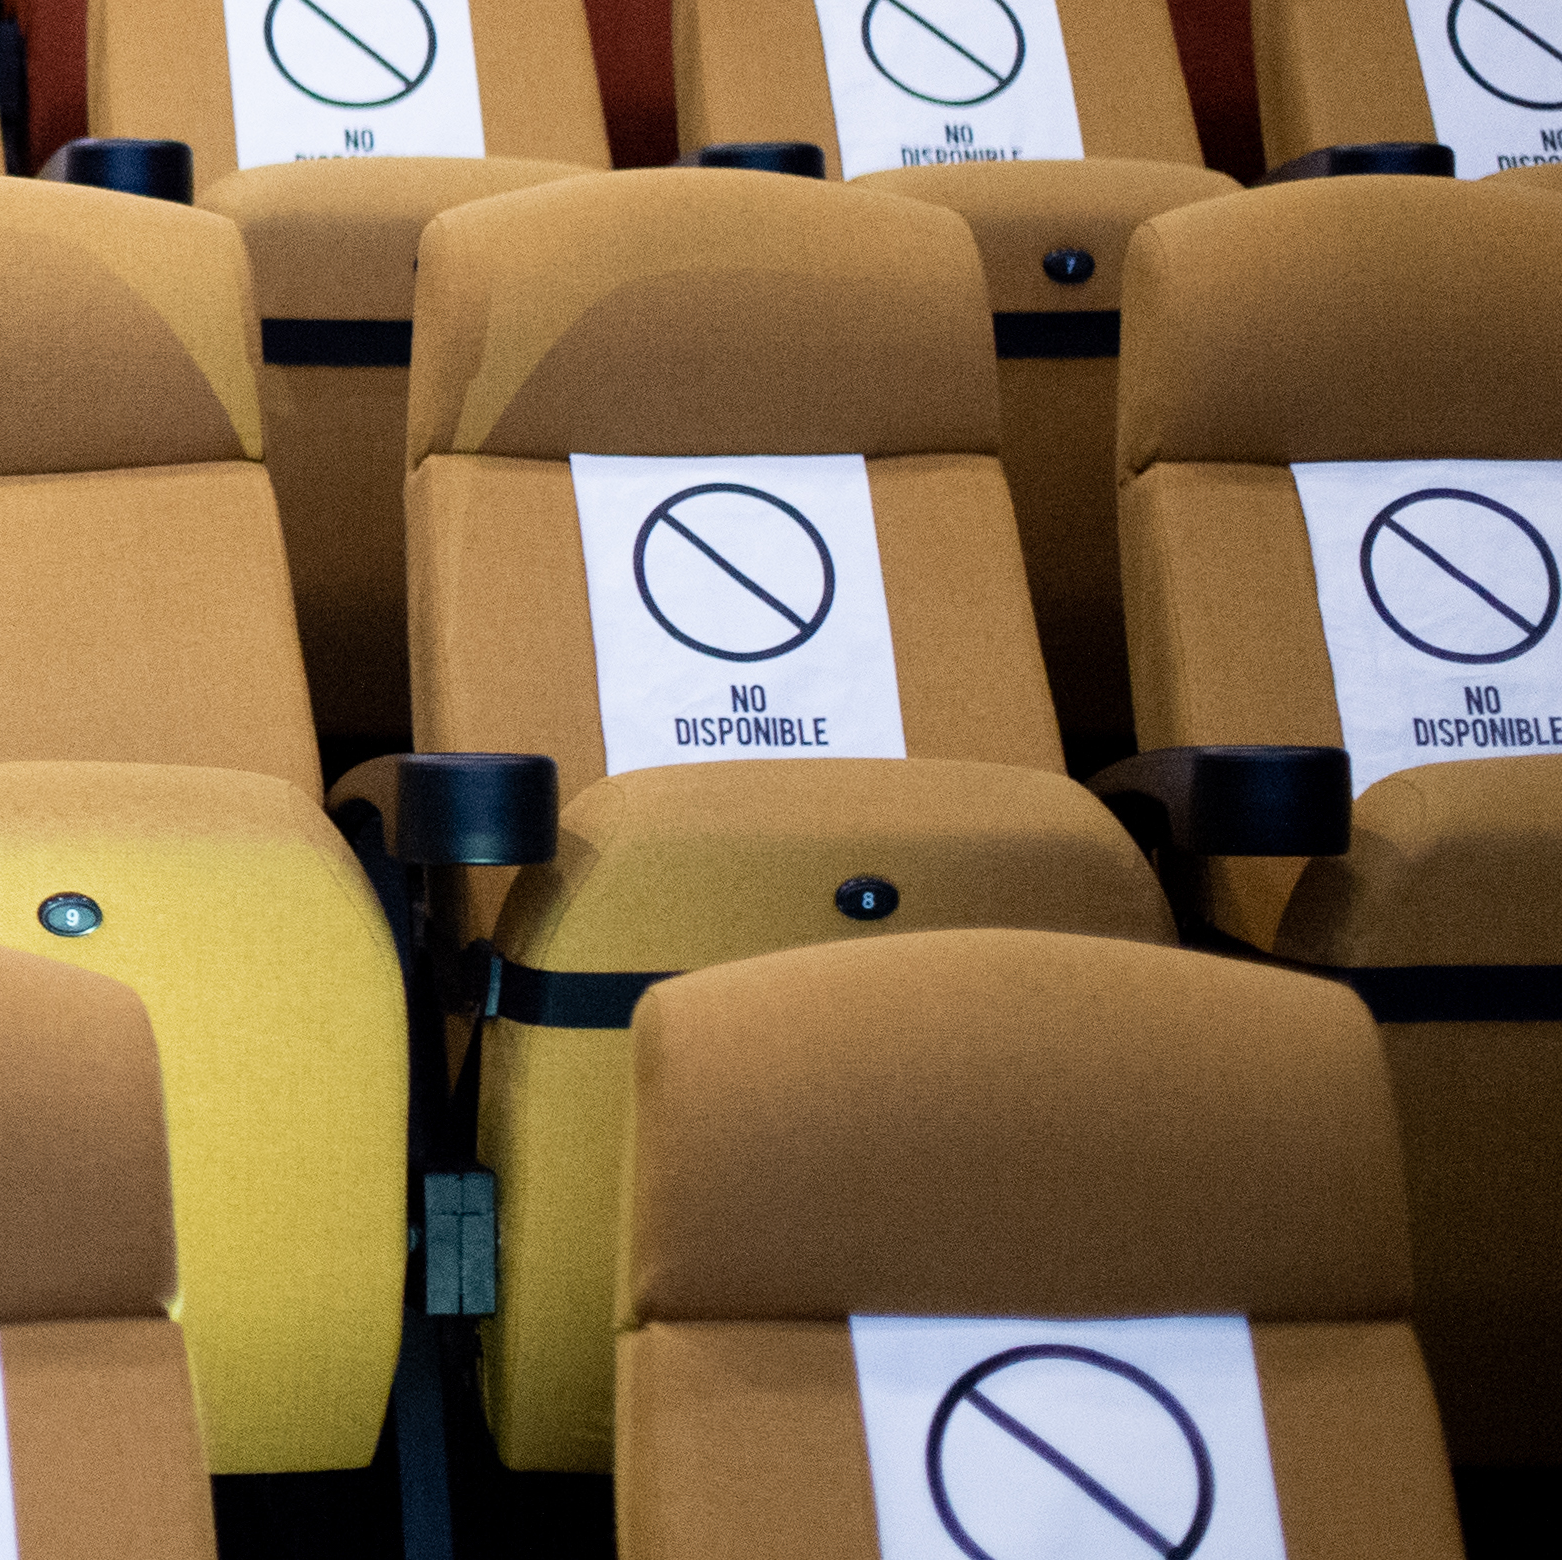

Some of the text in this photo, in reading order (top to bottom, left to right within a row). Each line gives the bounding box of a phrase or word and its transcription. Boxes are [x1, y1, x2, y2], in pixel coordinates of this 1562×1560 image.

[344, 127, 375, 152] NO
[944, 124, 974, 144] NO
[730, 684, 767, 713] NO
[1463, 685, 1501, 715] NO
[674, 717, 829, 747] DISPONIBLE
[1413, 716, 1562, 747] DISPONIBLE
[861, 892, 874, 909] 8
[65, 908, 80, 927] 9
